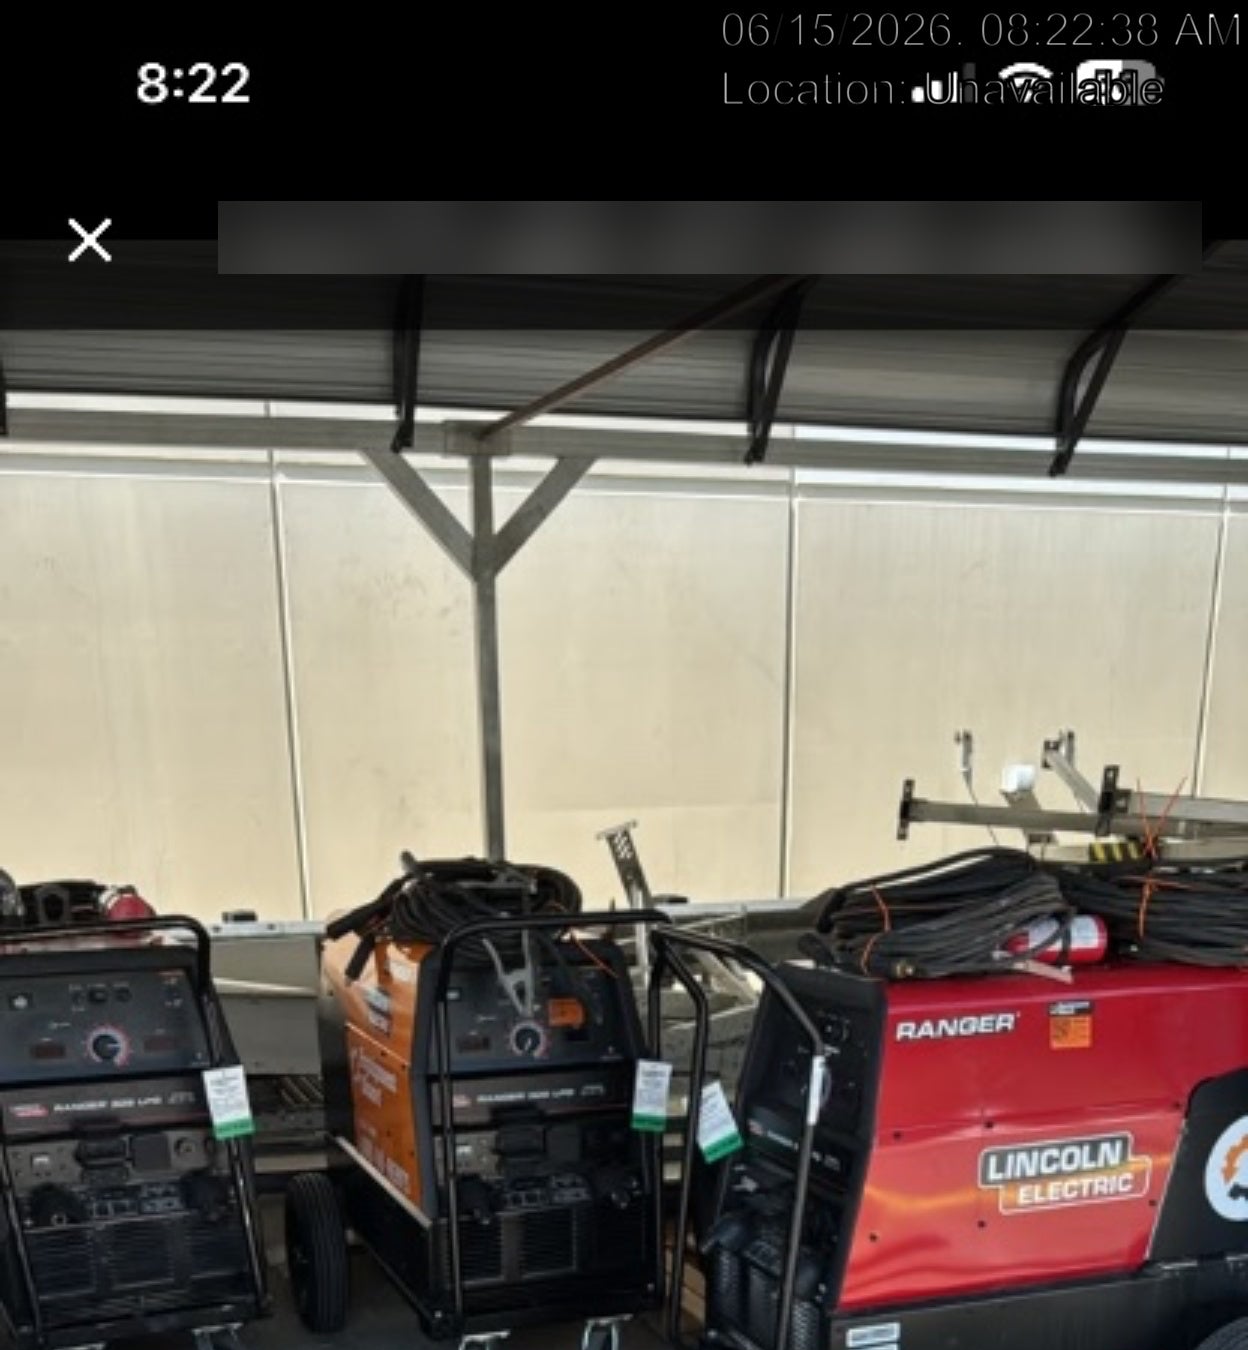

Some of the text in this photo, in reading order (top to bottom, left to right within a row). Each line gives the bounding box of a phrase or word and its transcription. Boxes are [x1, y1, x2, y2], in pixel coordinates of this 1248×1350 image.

[896, 1013, 1016, 1042] RANGER
[987, 1139, 1123, 1182] LINCOLN
[1017, 1172, 1135, 1205] ELECTRIC
